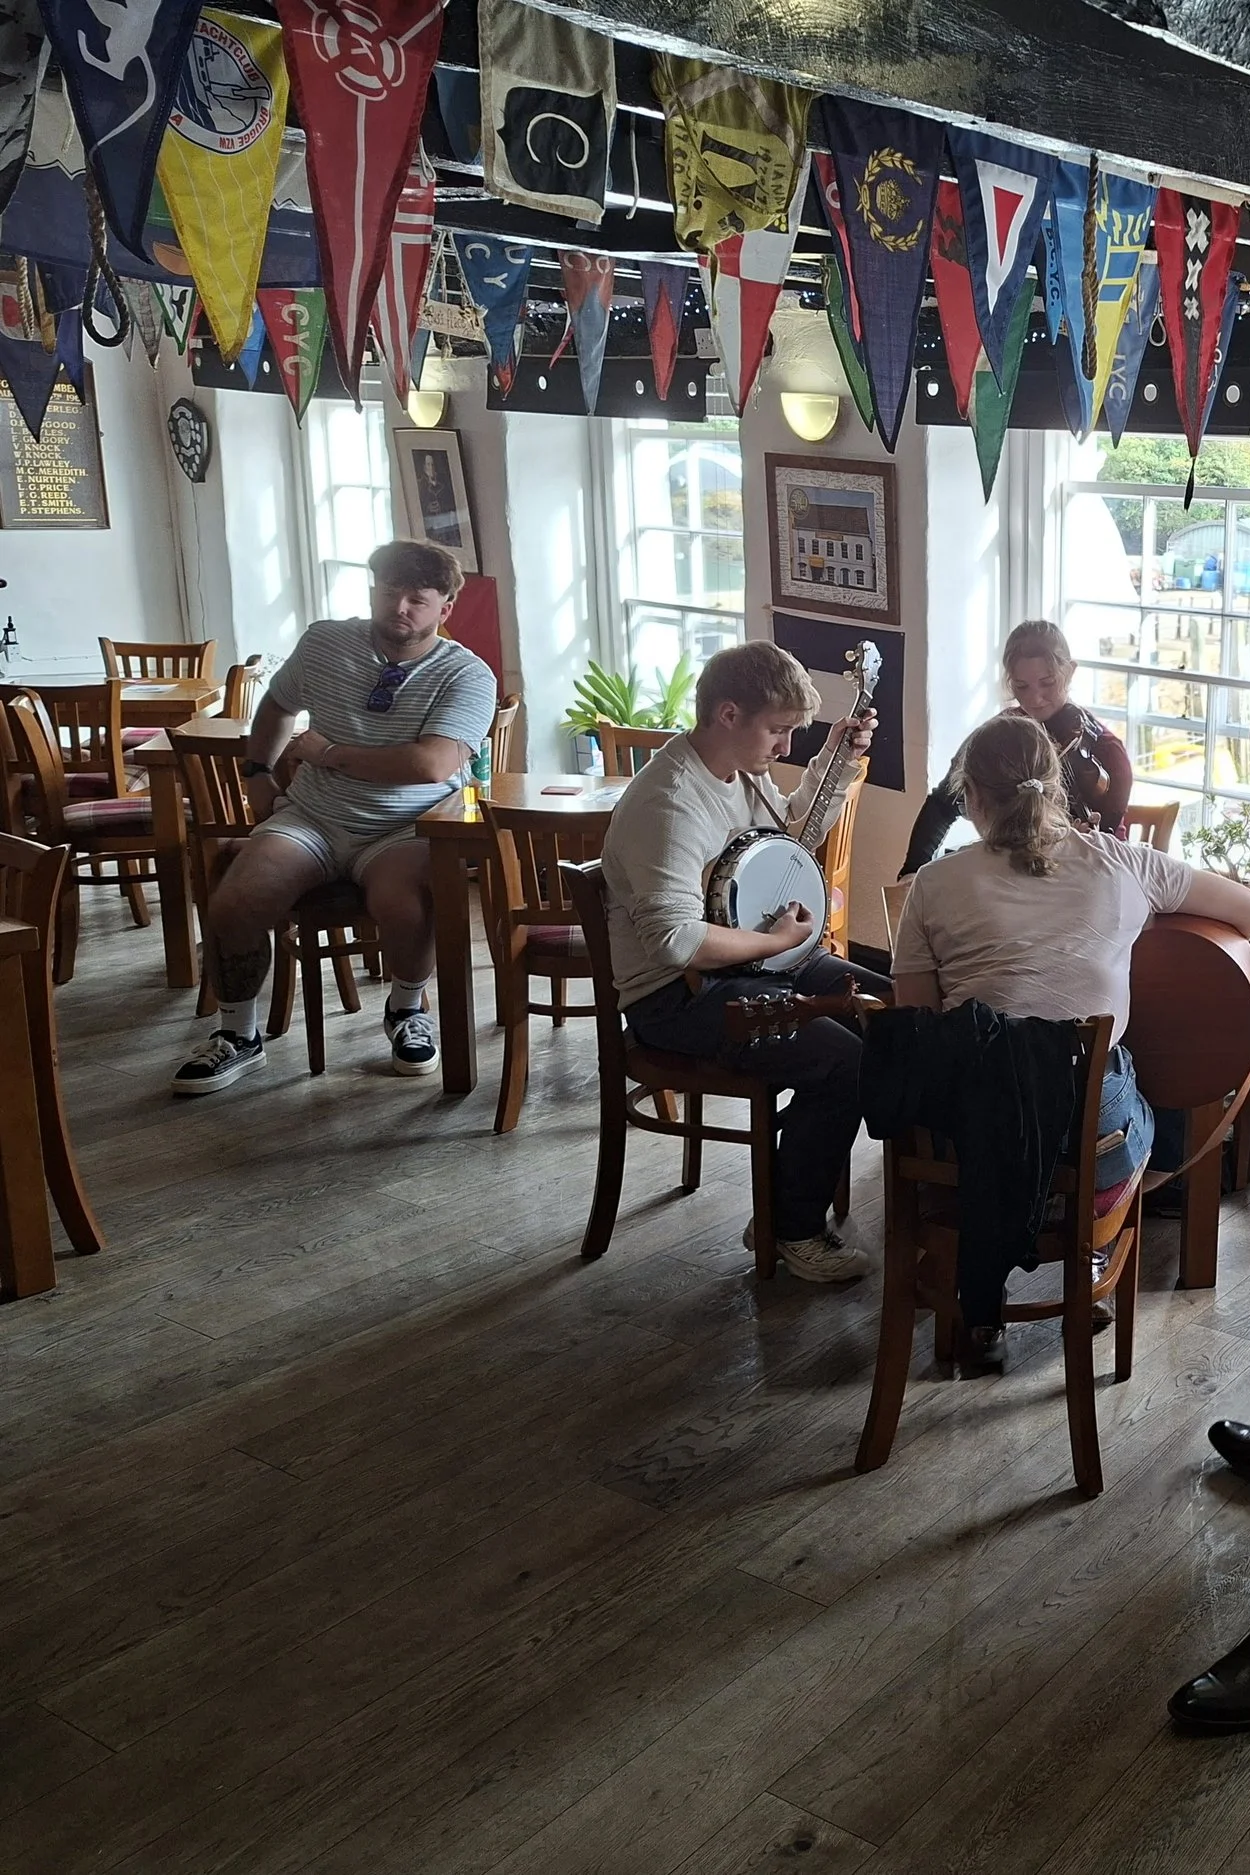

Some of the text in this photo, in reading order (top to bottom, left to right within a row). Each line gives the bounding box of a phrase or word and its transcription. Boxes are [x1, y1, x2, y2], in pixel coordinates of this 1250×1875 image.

[196, 22, 260, 82] ACHTCLUB
[238, 106, 269, 146] BRUGGE
[282, 303, 313, 376] CYC
